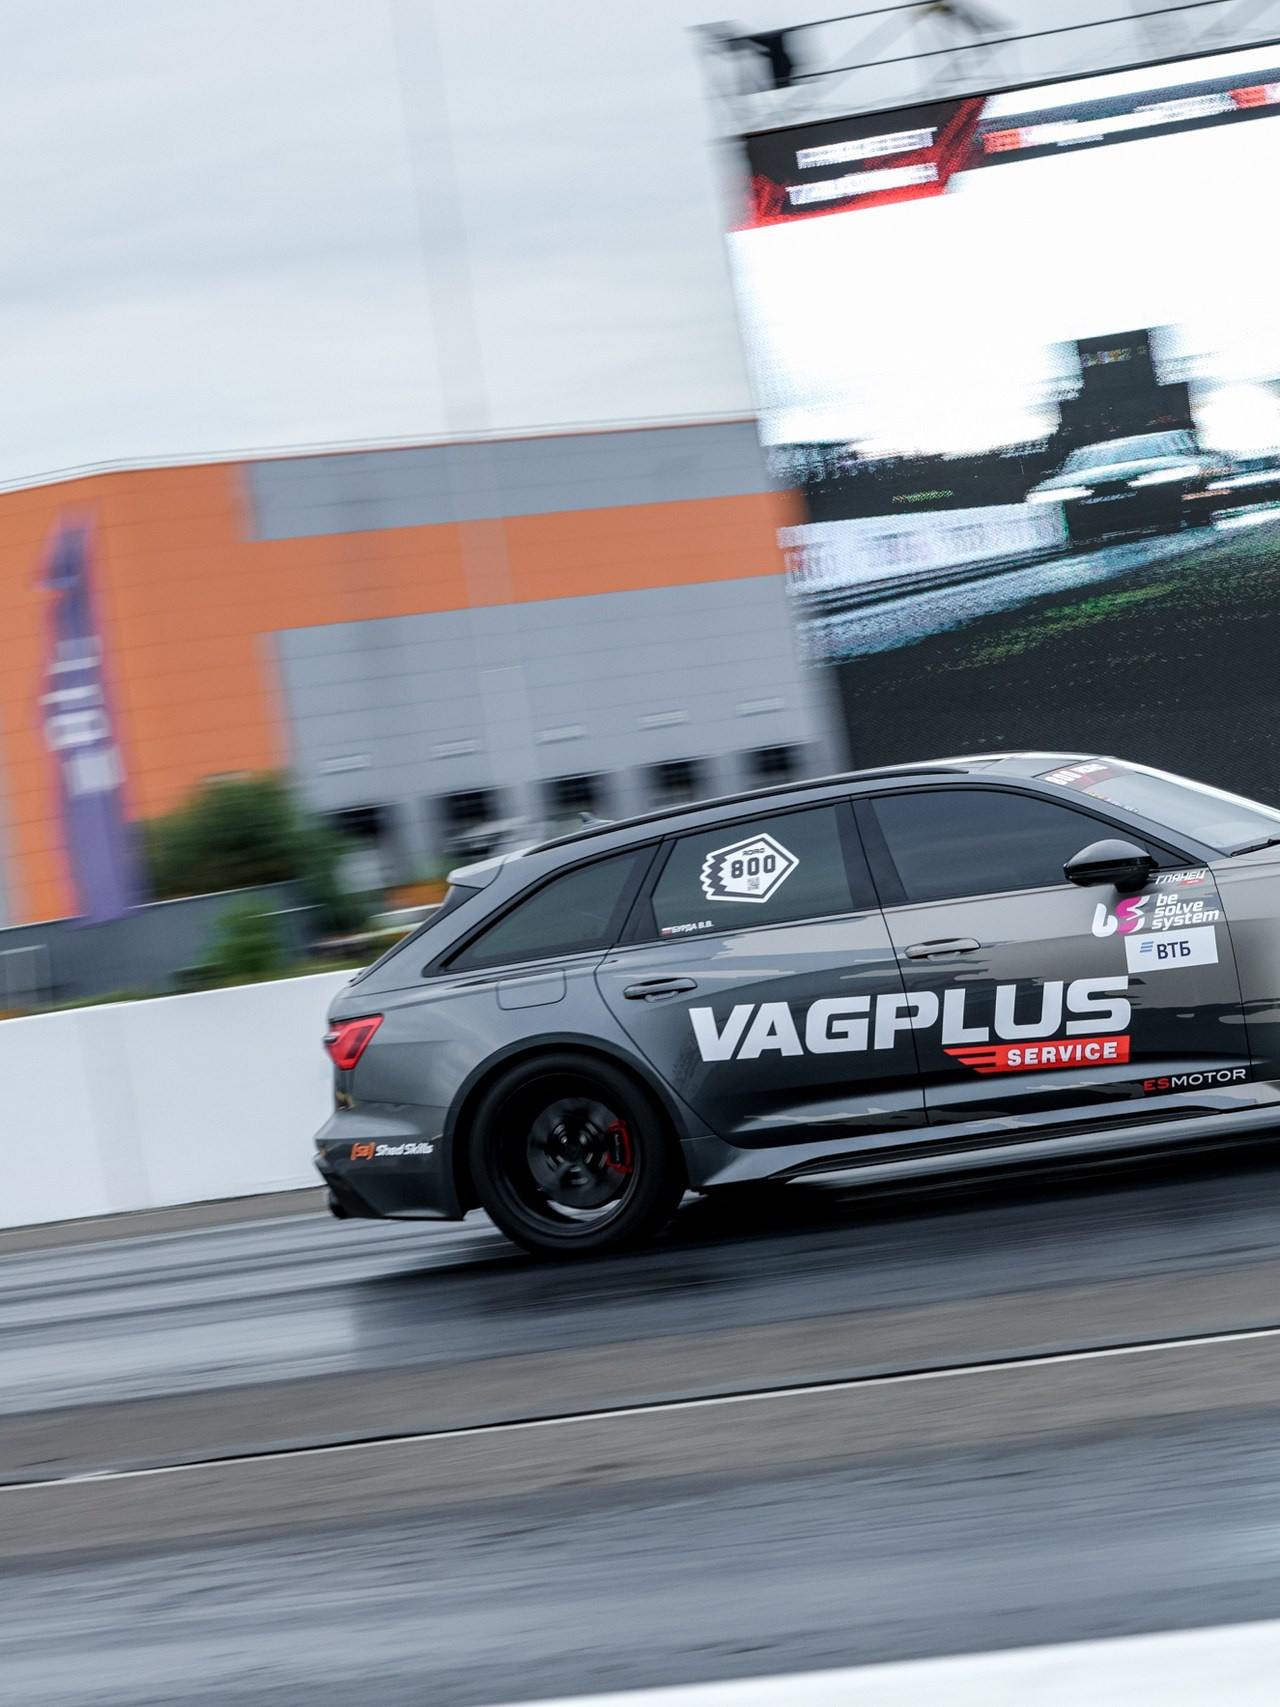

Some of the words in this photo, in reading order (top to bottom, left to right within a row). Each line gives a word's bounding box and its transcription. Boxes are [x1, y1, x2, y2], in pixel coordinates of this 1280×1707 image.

[731, 854, 776, 879] 800
[1155, 870, 1207, 885] ГЛЯНЕЦ
[1153, 901, 1204, 918] solve
[1156, 893, 1178, 907] be
[1151, 910, 1220, 931] system
[1156, 940, 1191, 960] ВТБ
[689, 976, 1131, 1062] VAGPLUS
[1007, 1041, 1118, 1067] SERVICE
[1143, 1068, 1246, 1091] ESMOTOR
